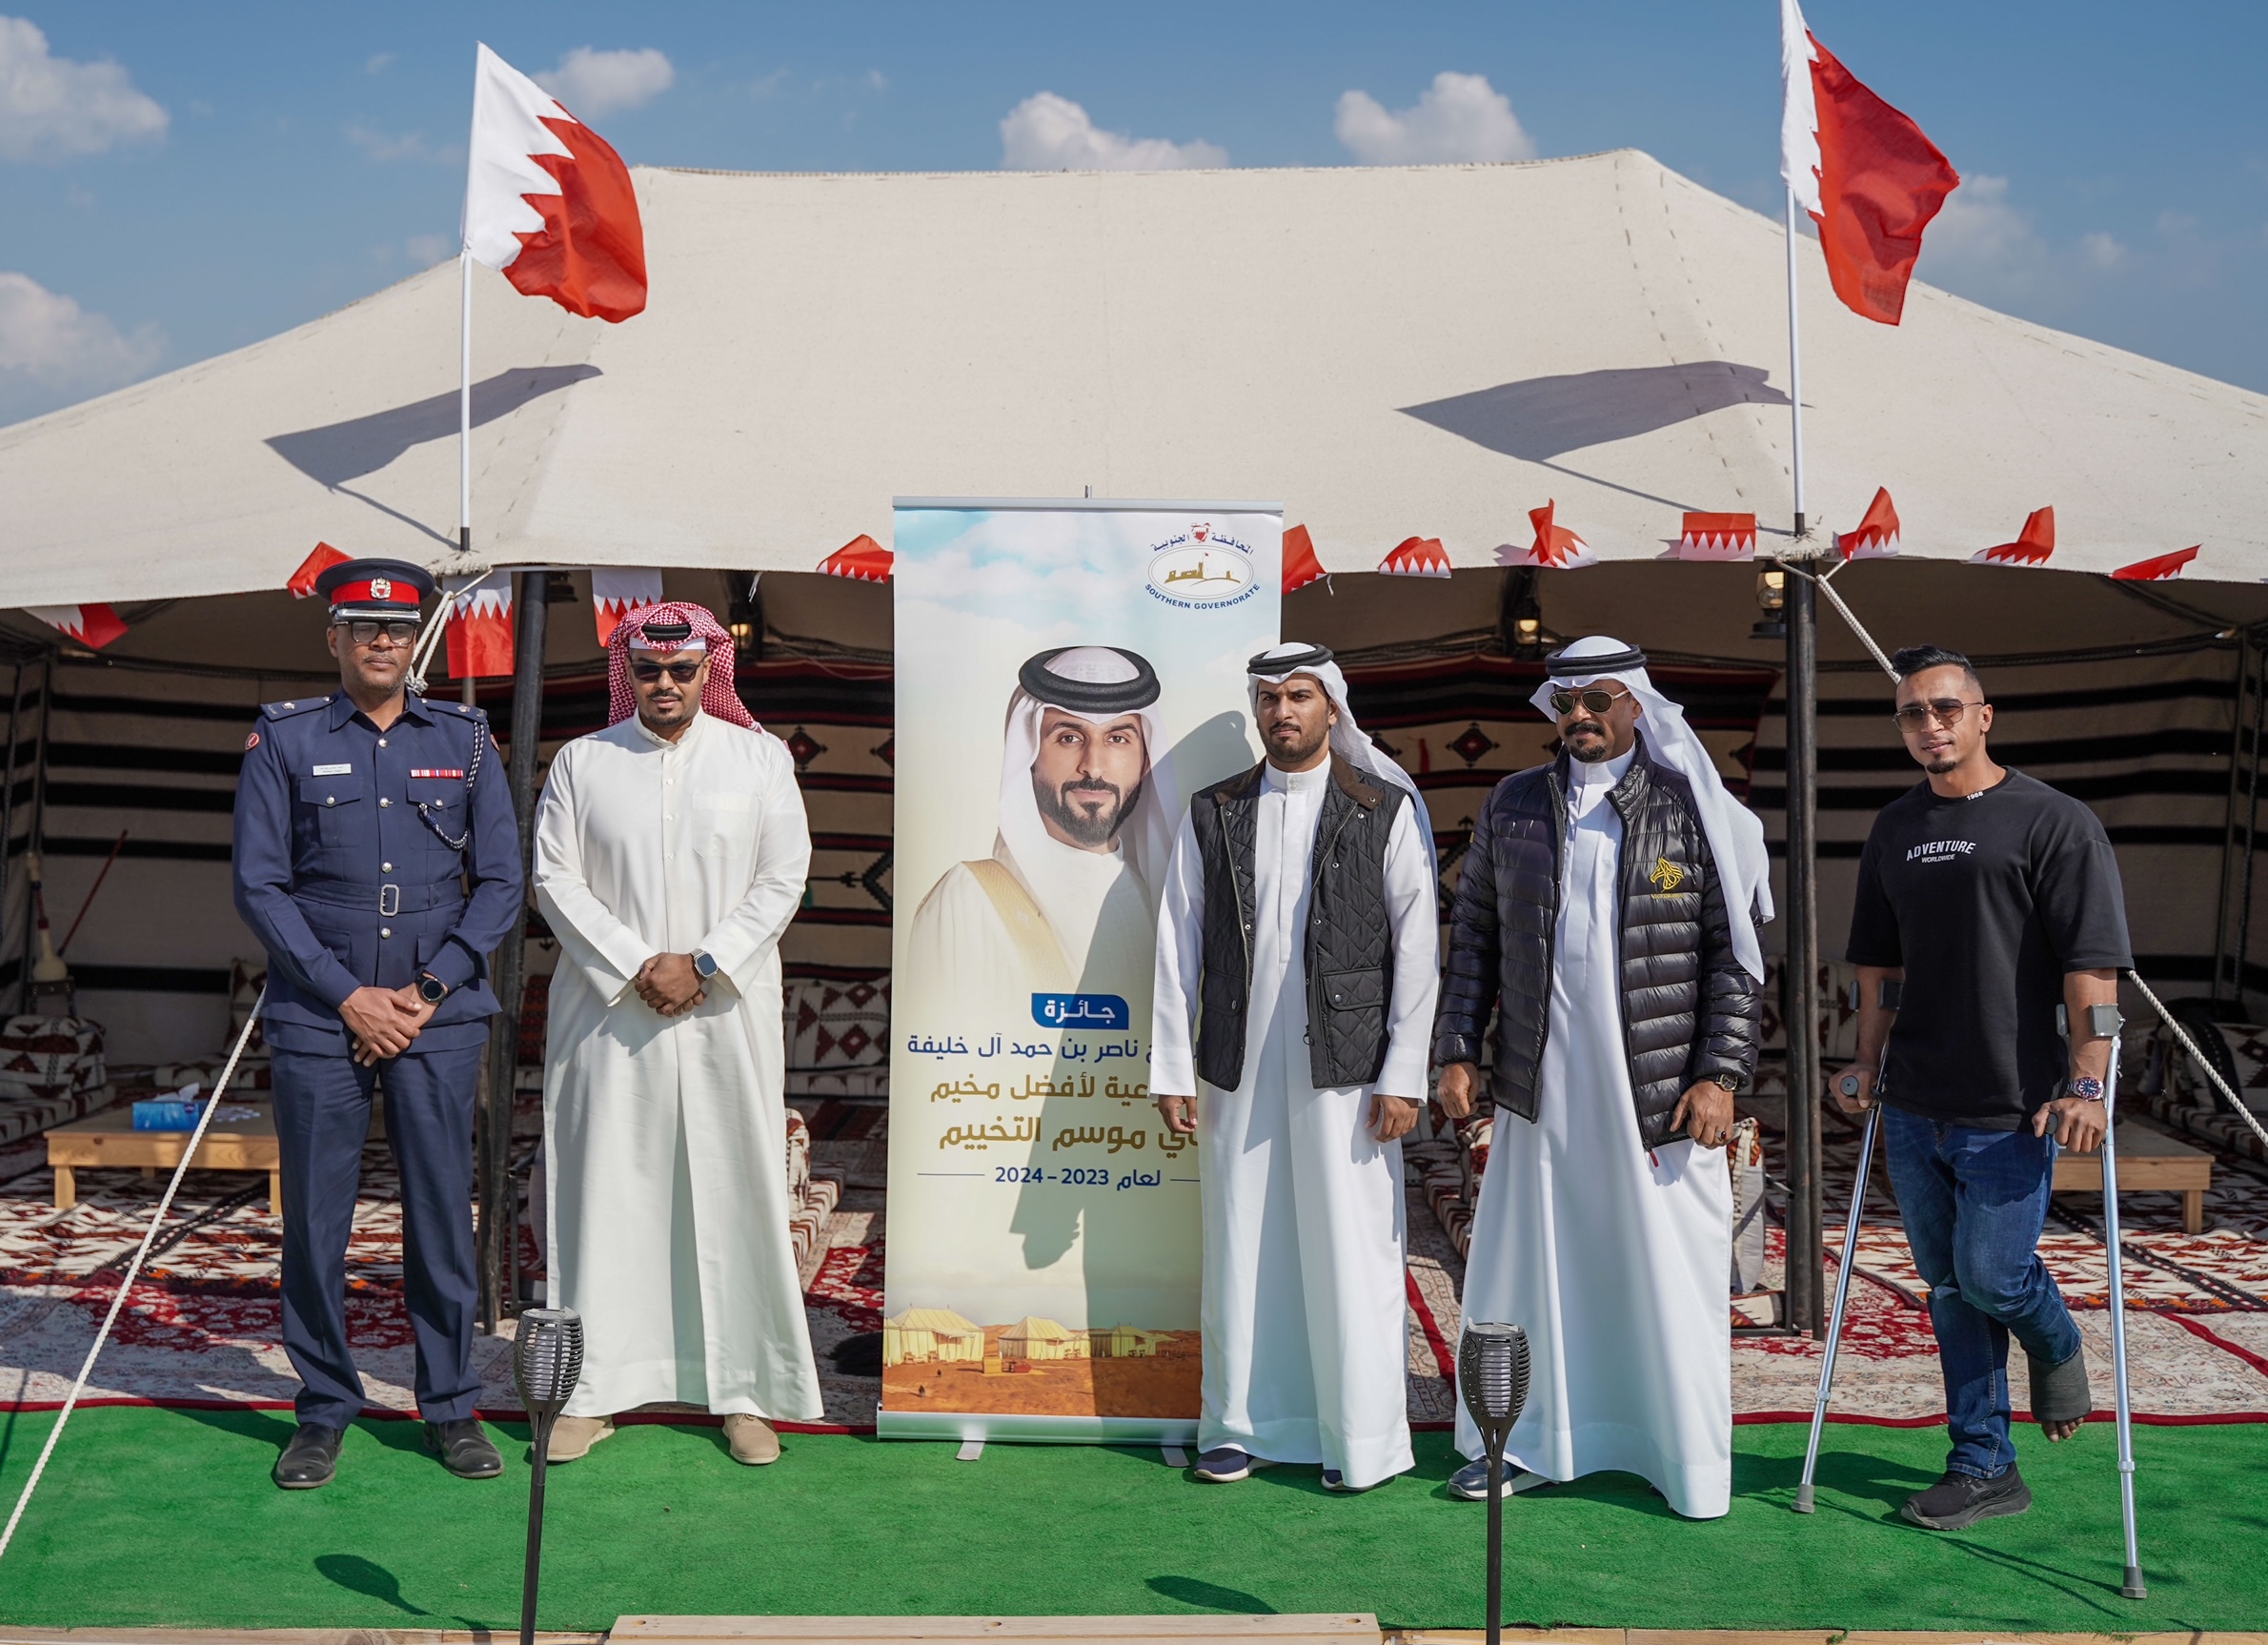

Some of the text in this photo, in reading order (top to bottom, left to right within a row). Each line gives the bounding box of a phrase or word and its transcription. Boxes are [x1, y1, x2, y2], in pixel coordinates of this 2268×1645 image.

[1150, 532, 1254, 556] المحافظة الجنوبية
[1144, 583, 1261, 610] SOUTHERN GOVERNORATE
[1906, 840, 1976, 862] ADVENTURE
[1921, 854, 1956, 863] WORLDWIDE
[1043, 999, 1116, 1025] جائزة
[907, 1034, 968, 1060] خليفة
[978, 1032, 1002, 1058] آل
[1010, 1040, 1053, 1059] حمد
[1061, 1037, 1087, 1064] بن
[1094, 1038, 1139, 1064] ناصر
[930, 1072, 1001, 1104] مخيم
[1010, 1071, 1096, 1101] لأفضل
[939, 1115, 1042, 1150] التخييم
[1052, 1125, 1145, 1154] موسم
[1116, 1168, 1162, 1191] لعام
